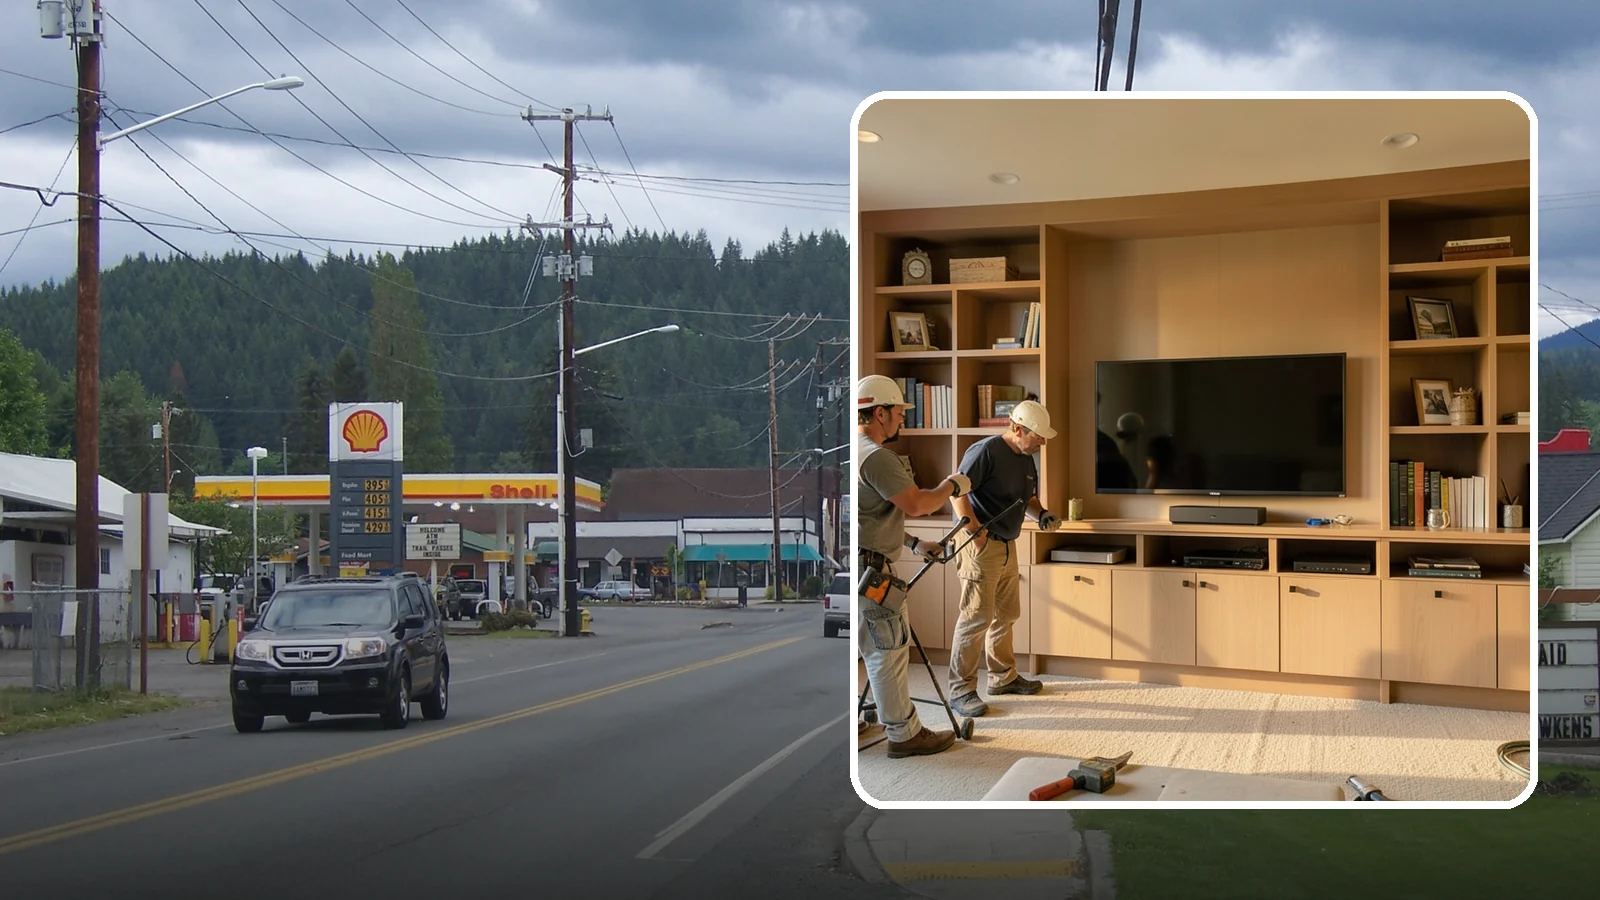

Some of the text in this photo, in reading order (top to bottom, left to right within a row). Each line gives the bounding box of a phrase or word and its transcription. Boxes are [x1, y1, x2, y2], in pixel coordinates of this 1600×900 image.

[366, 480, 383, 490] 395
[490, 484, 547, 499] Shell
[366, 494, 383, 504] 405
[366, 508, 383, 518] 415
[366, 522, 383, 532] 429
